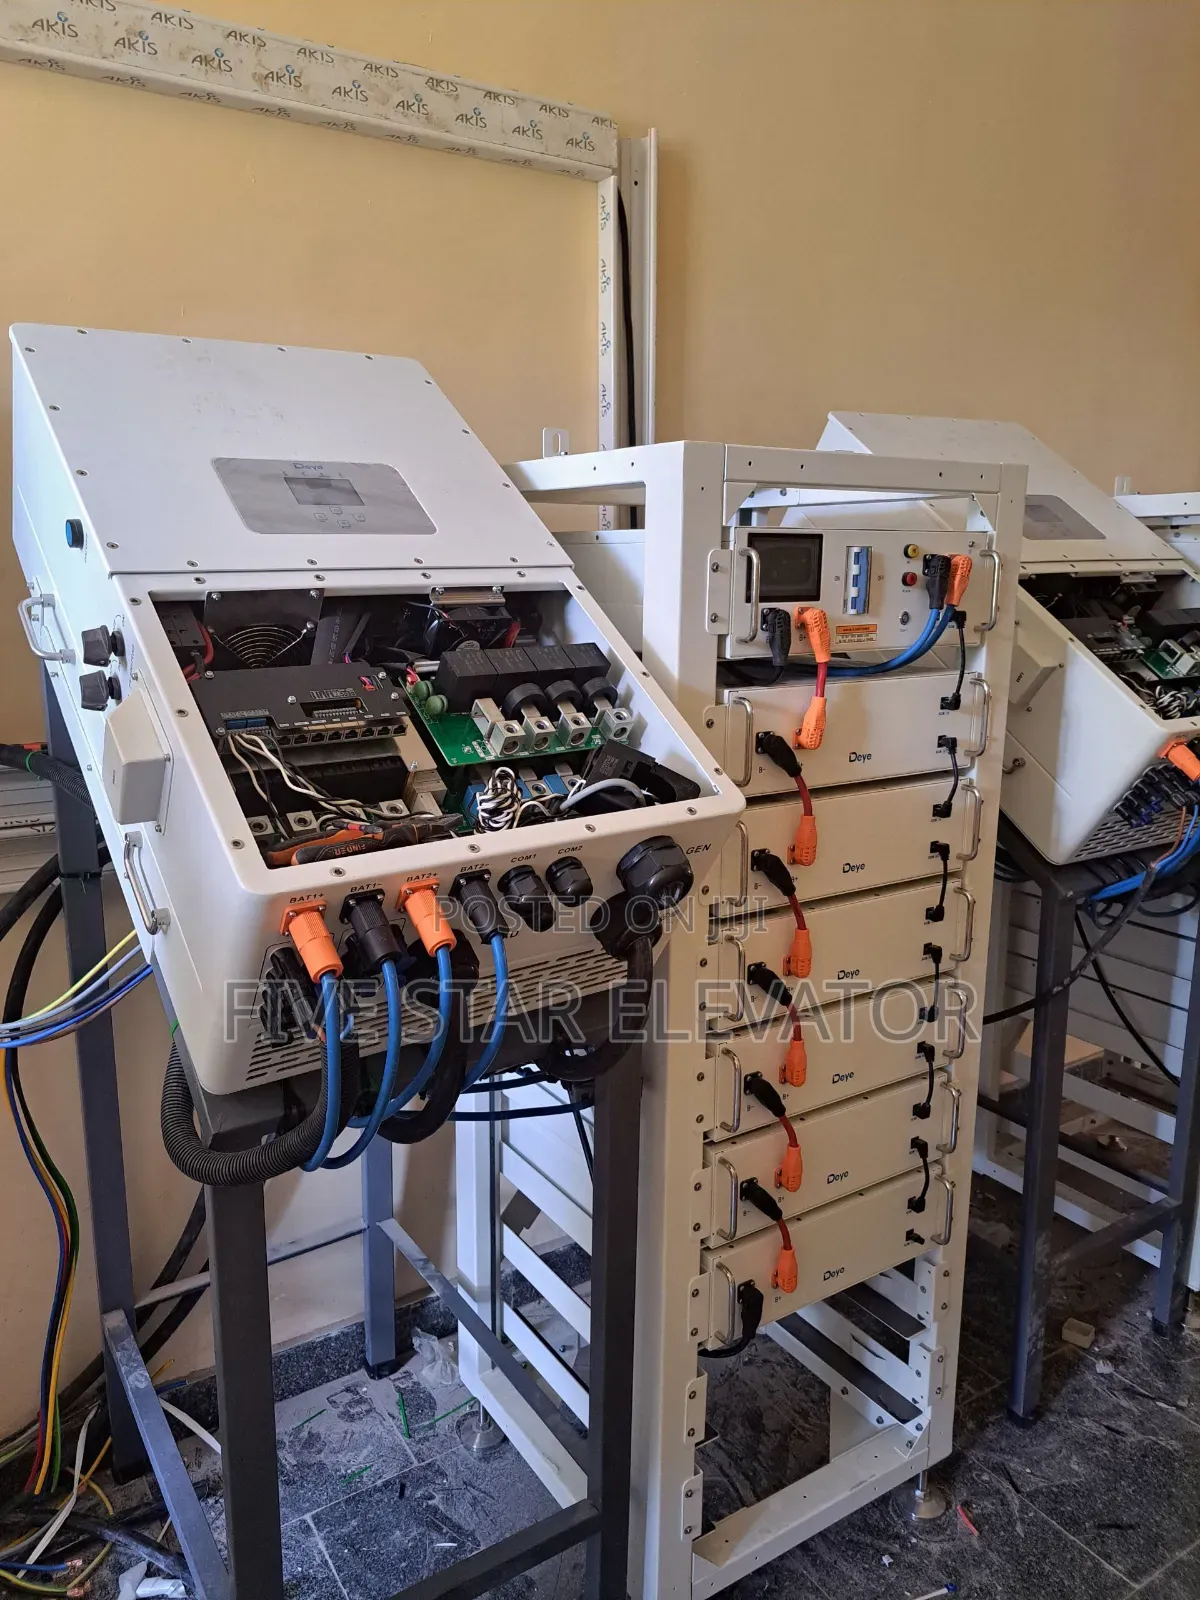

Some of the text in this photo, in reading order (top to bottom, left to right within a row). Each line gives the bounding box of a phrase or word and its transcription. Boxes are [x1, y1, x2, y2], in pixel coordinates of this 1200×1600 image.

[32, 18, 79, 38] AKIS
[150, 11, 194, 30] AKIS
[114, 37, 158, 56] AKIS
[225, 30, 267, 48] AKIS
[296, 47, 335, 64] AKIS
[191, 54, 233, 73] AKIS
[363, 63, 399, 79] AKIS
[264, 70, 303, 88] AKIS
[425, 77, 458, 93] AKIS
[332, 85, 369, 103] AKIS
[483, 91, 515, 106] AKIS
[395, 99, 430, 116] AKIS
[539, 104, 570, 119] AKIS
[455, 113, 487, 129] AKIS
[512, 125, 543, 141] AKIS
[566, 137, 595, 152] AKIS
[849, 751, 872, 762] Deye
[333, 843, 366, 856] FINDER
[558, 845, 583, 854] COM2
[685, 843, 712, 854] GEN
[510, 853, 537, 862] COM1
[460, 863, 490, 872] BAT2-
[842, 862, 865, 874] Deye
[407, 873, 438, 882] BAT2+
[350, 883, 383, 892] BAT1-
[290, 892, 325, 903] BAT1+
[837, 968, 860, 980] Deye
[832, 1071, 855, 1084] Deye
[826, 1169, 849, 1184] Deye
[823, 1266, 845, 1281] Deye
